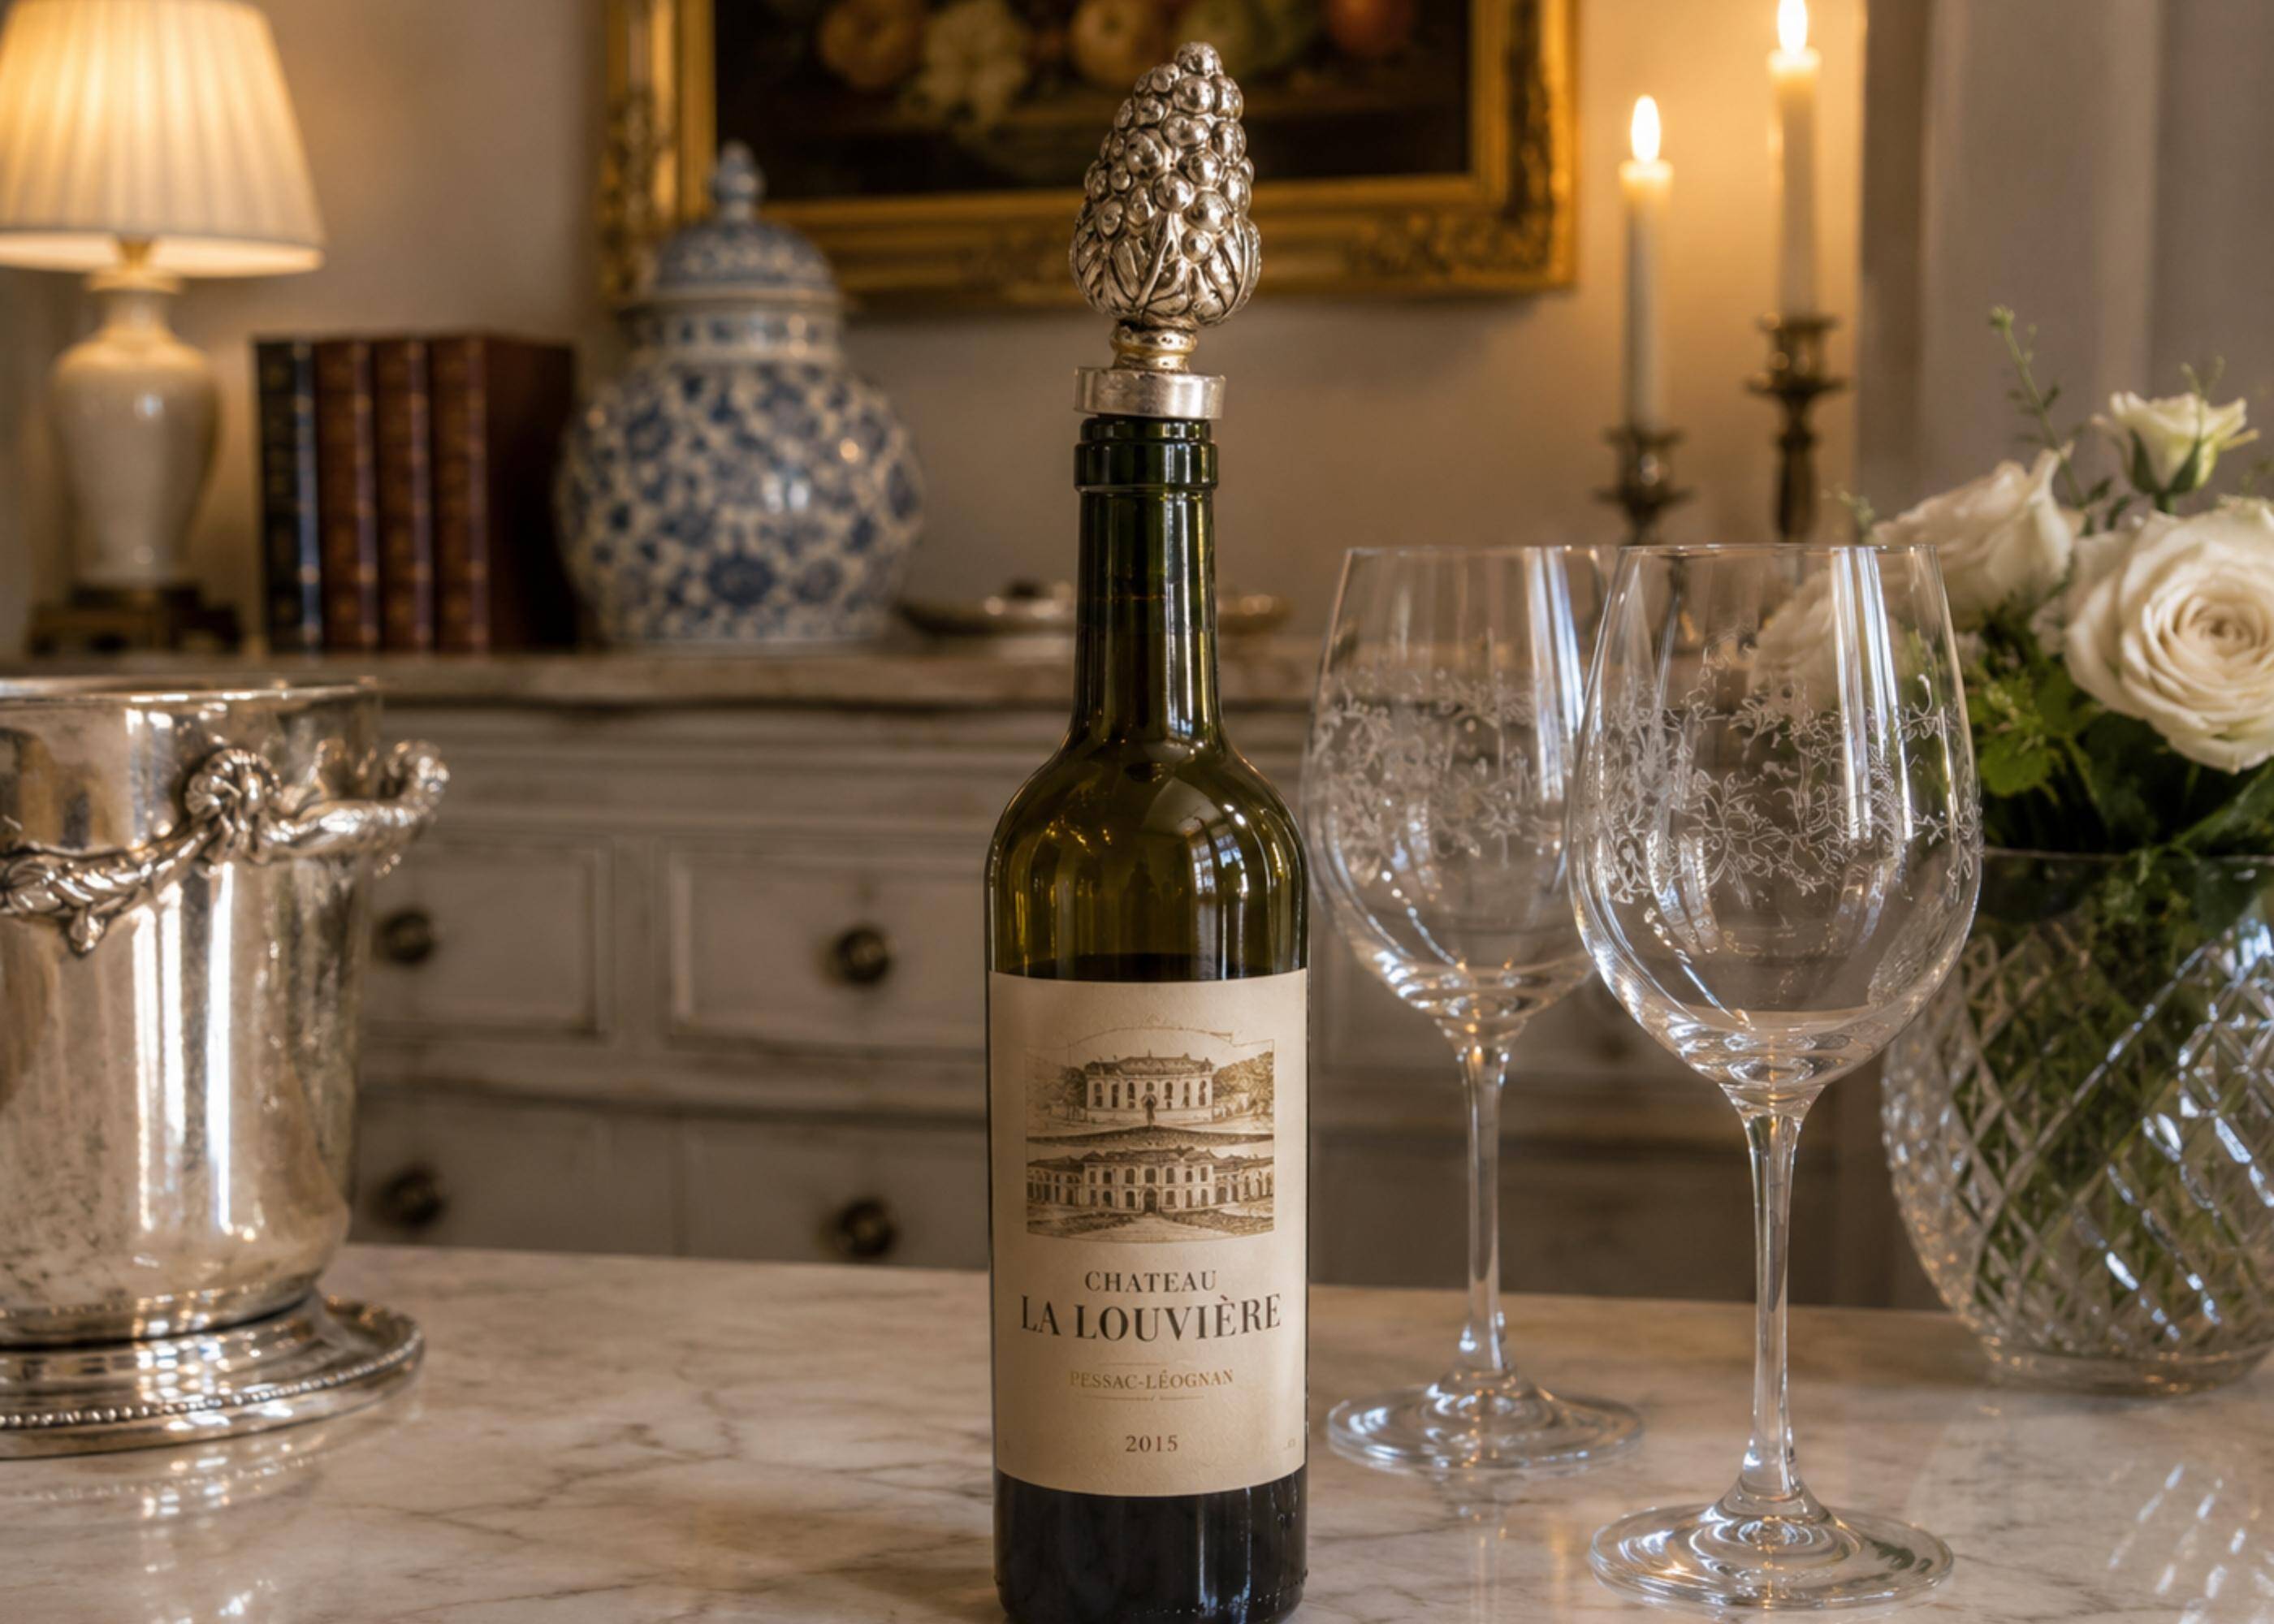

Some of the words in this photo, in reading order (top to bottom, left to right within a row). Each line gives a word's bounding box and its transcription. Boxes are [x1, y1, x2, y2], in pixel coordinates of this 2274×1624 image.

[1085, 1270, 1217, 1293] CHATEAU
[1021, 1295, 1061, 1336] LA
[1074, 1294, 1282, 1341] LOUVIÈRE
[1070, 1368, 1234, 1389] PESSAC-LÉOGNAN
[1125, 1435, 1178, 1453] 2015
